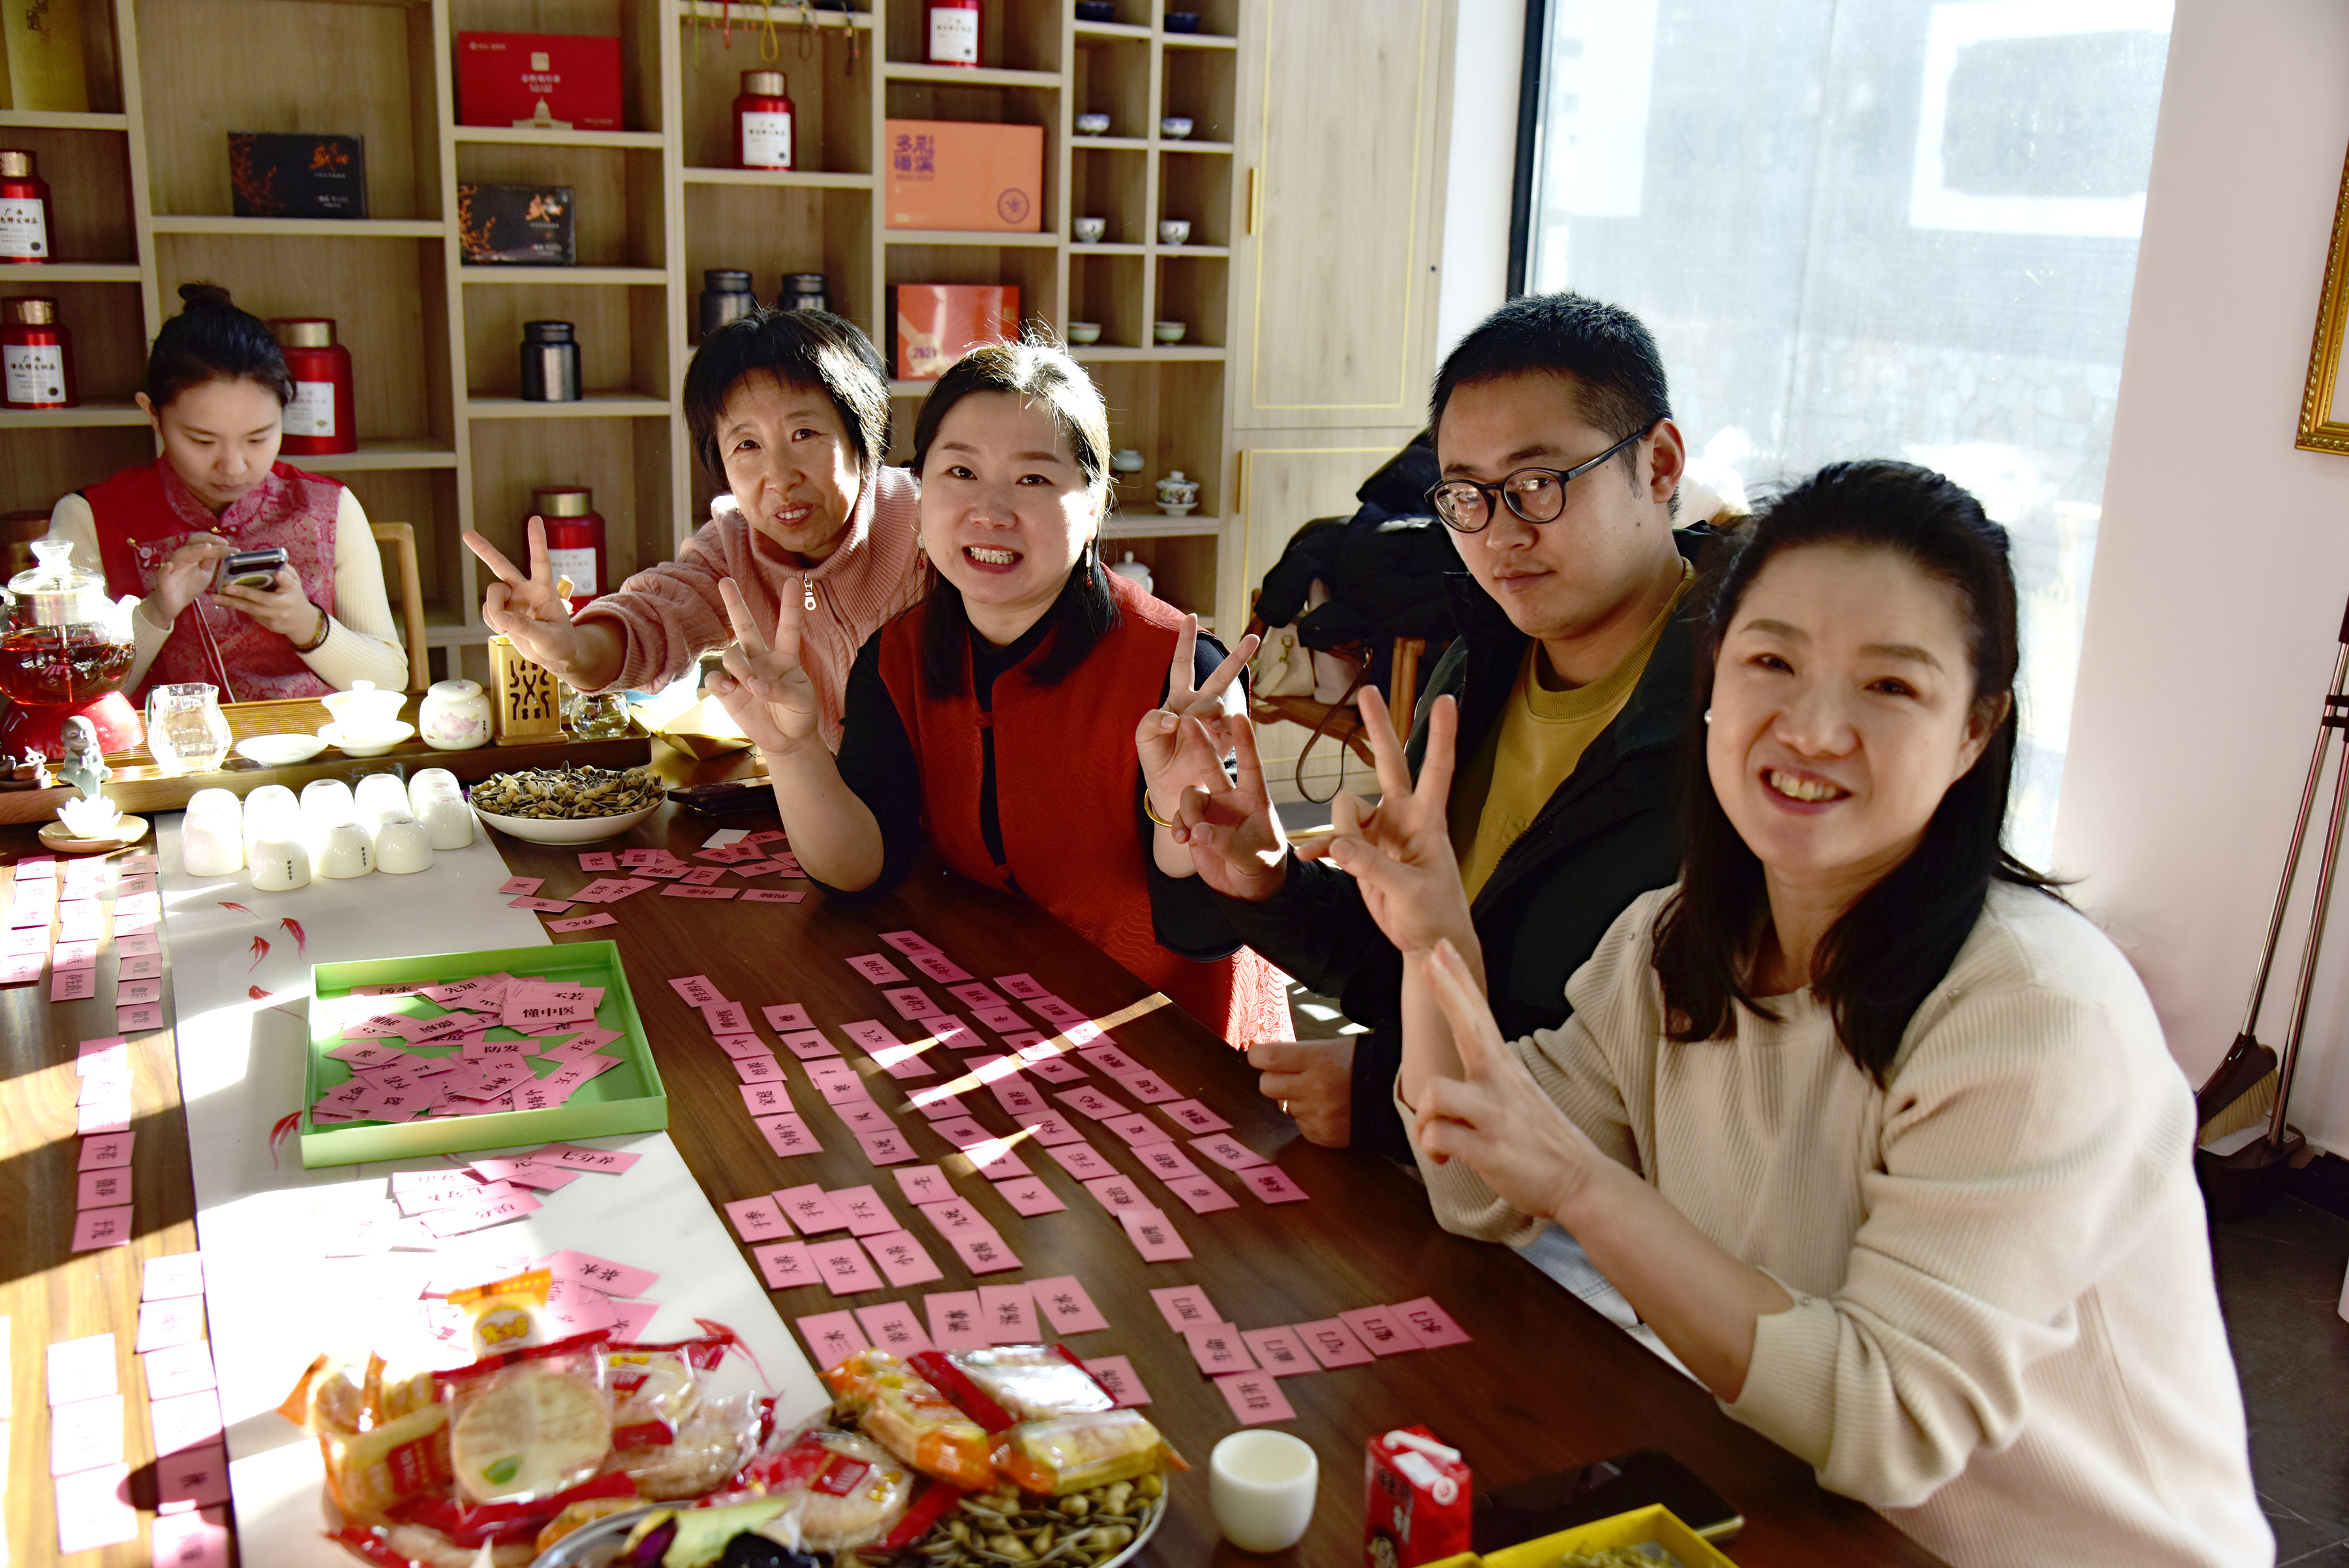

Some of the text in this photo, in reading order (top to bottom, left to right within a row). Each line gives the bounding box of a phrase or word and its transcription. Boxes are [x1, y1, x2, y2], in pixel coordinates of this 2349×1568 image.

[863, 961, 889, 976] 十分防
[66, 973, 83, 996] 养生的人
[683, 979, 714, 1003] 养生的人
[523, 1005, 575, 1019] 懂中医
[900, 994, 927, 1011] 七分养
[717, 1009, 738, 1028] 懂中医
[732, 1039, 748, 1051] 一个
[747, 1061, 769, 1076] 培养
[1135, 1080, 1164, 1094] 先知
[756, 1090, 778, 1106] 家庭
[1079, 1095, 1107, 1110] 养心
[853, 1111, 870, 1122] 风
[775, 1123, 801, 1147] 为每个
[561, 1152, 617, 1165] 七分养
[913, 1176, 934, 1194] 一生
[797, 1200, 824, 1217] 于年
[849, 1201, 876, 1220] 于天
[940, 1208, 975, 1227] 九死
[745, 1210, 771, 1229] 于季
[885, 1245, 915, 1265] 小养
[970, 1241, 998, 1262] 掌握
[773, 1255, 803, 1274] 大养
[829, 1255, 857, 1275] 长养
[998, 1302, 1022, 1325] 汤水
[1053, 1293, 1081, 1315] 茶水
[1172, 1297, 1203, 1321] 四门
[945, 1309, 971, 1332] 酒水
[882, 1320, 913, 1343] 养生
[823, 1330, 852, 1353] 三水
[1205, 1338, 1234, 1362] 生命
[1238, 1382, 1271, 1409] 打开
